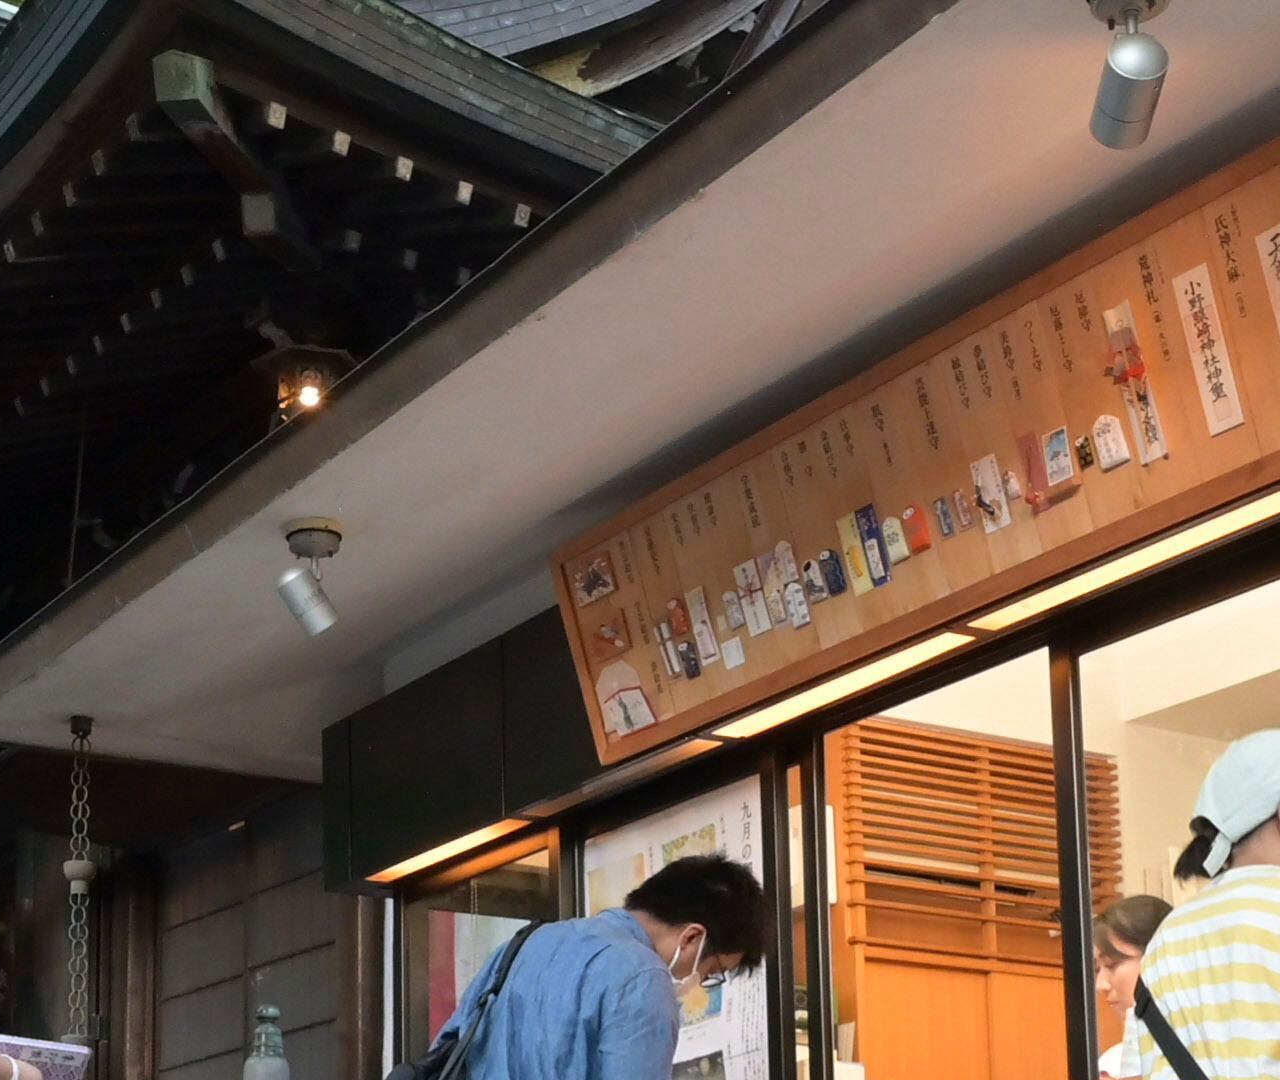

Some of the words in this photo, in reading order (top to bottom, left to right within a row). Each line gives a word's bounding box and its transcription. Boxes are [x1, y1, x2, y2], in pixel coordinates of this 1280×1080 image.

[1214, 213, 1244, 284] 氏神大麻
[741, 801, 753, 868] 九月の
